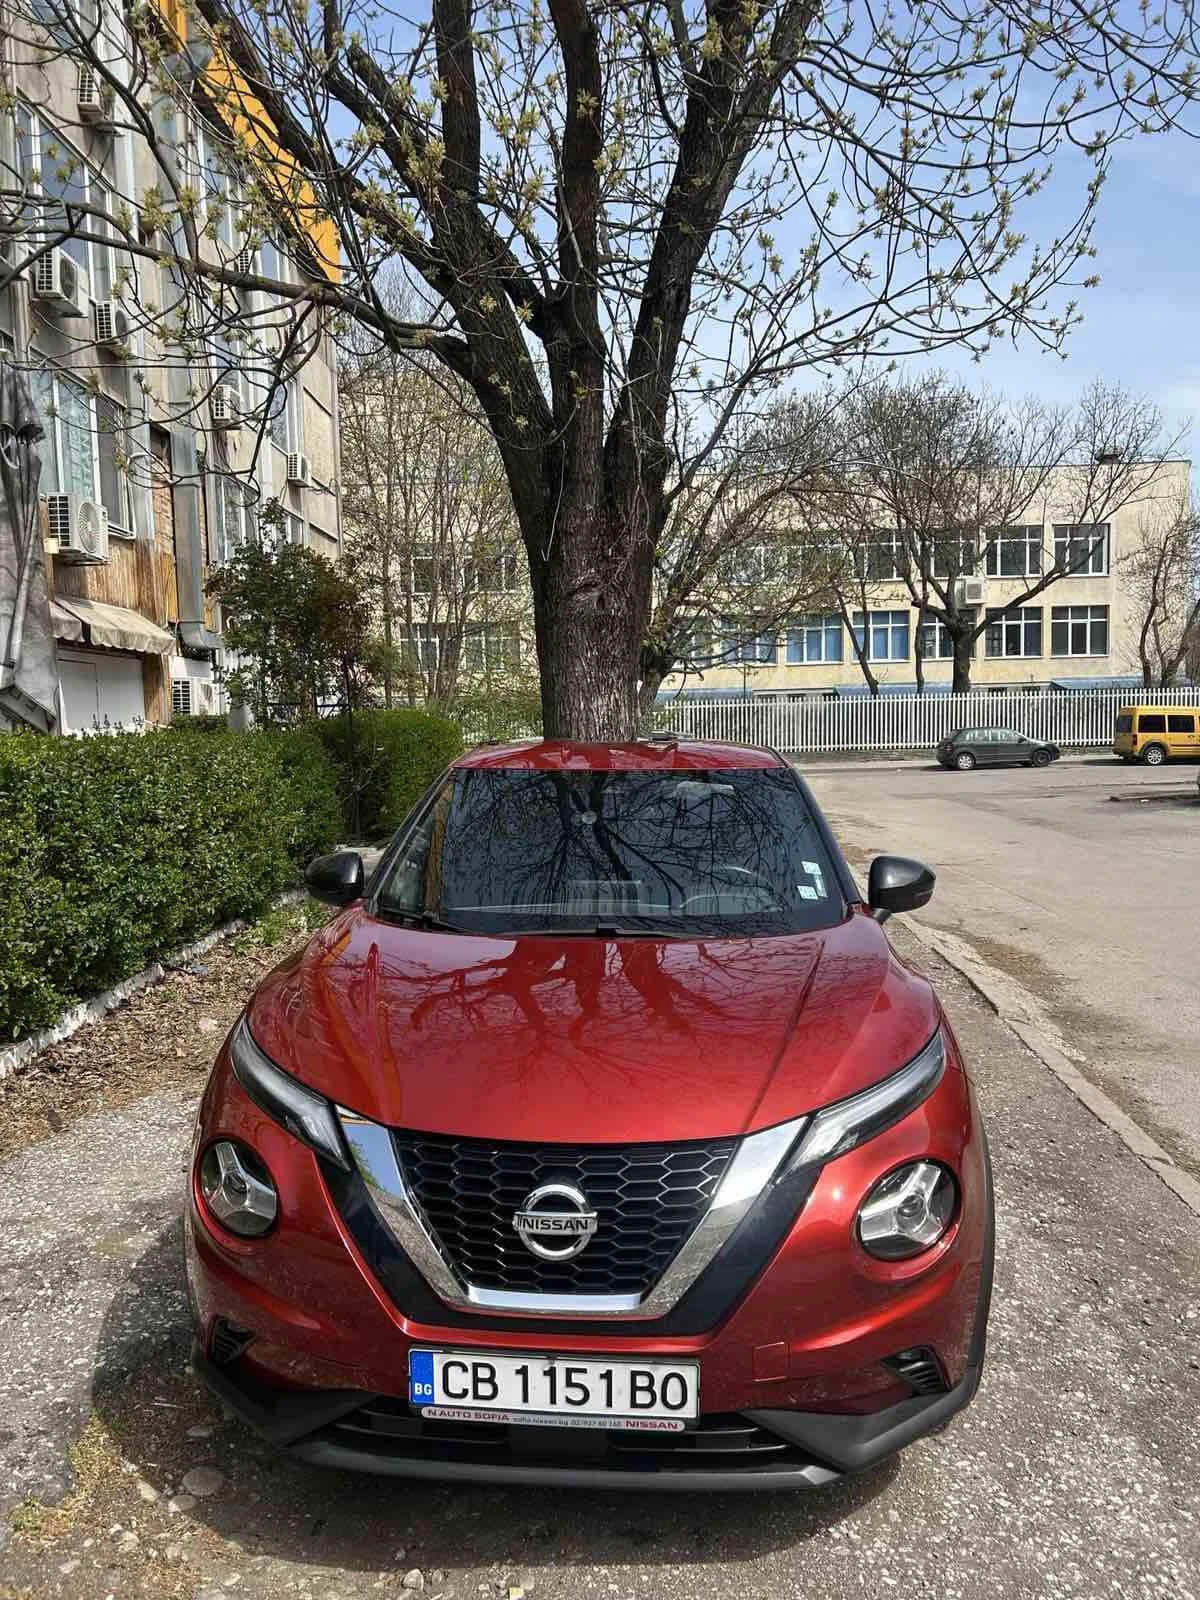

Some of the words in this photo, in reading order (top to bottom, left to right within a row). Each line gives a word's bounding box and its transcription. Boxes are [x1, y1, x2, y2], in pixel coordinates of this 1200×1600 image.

[522, 1218, 588, 1231] NISSAN
[414, 1383, 433, 1396] BG
[442, 1360, 499, 1401] CB
[515, 1365, 613, 1408] 1151
[440, 1410, 472, 1419] AUTO
[474, 1412, 510, 1421] SOFIA
[625, 1420, 679, 1430] NISSAN
